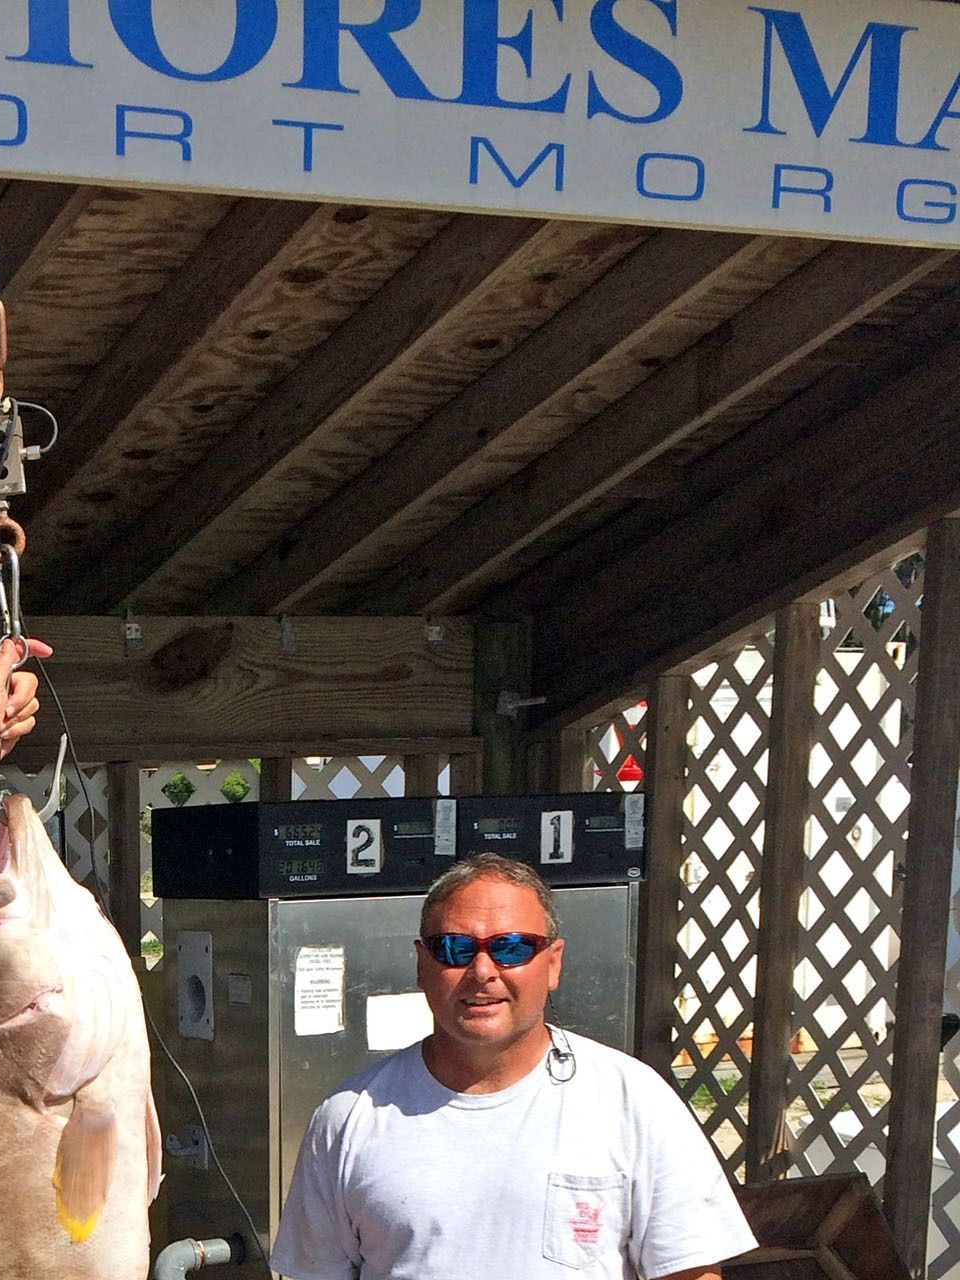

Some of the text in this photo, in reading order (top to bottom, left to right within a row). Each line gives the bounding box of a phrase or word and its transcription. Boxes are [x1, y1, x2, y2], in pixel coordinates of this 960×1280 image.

[468, 135, 959, 225] MORG
[304, 838, 321, 846] SALE
[350, 824, 376, 868] 2
[548, 814, 565, 860] 1
[289, 874, 317, 882] GALLONS
